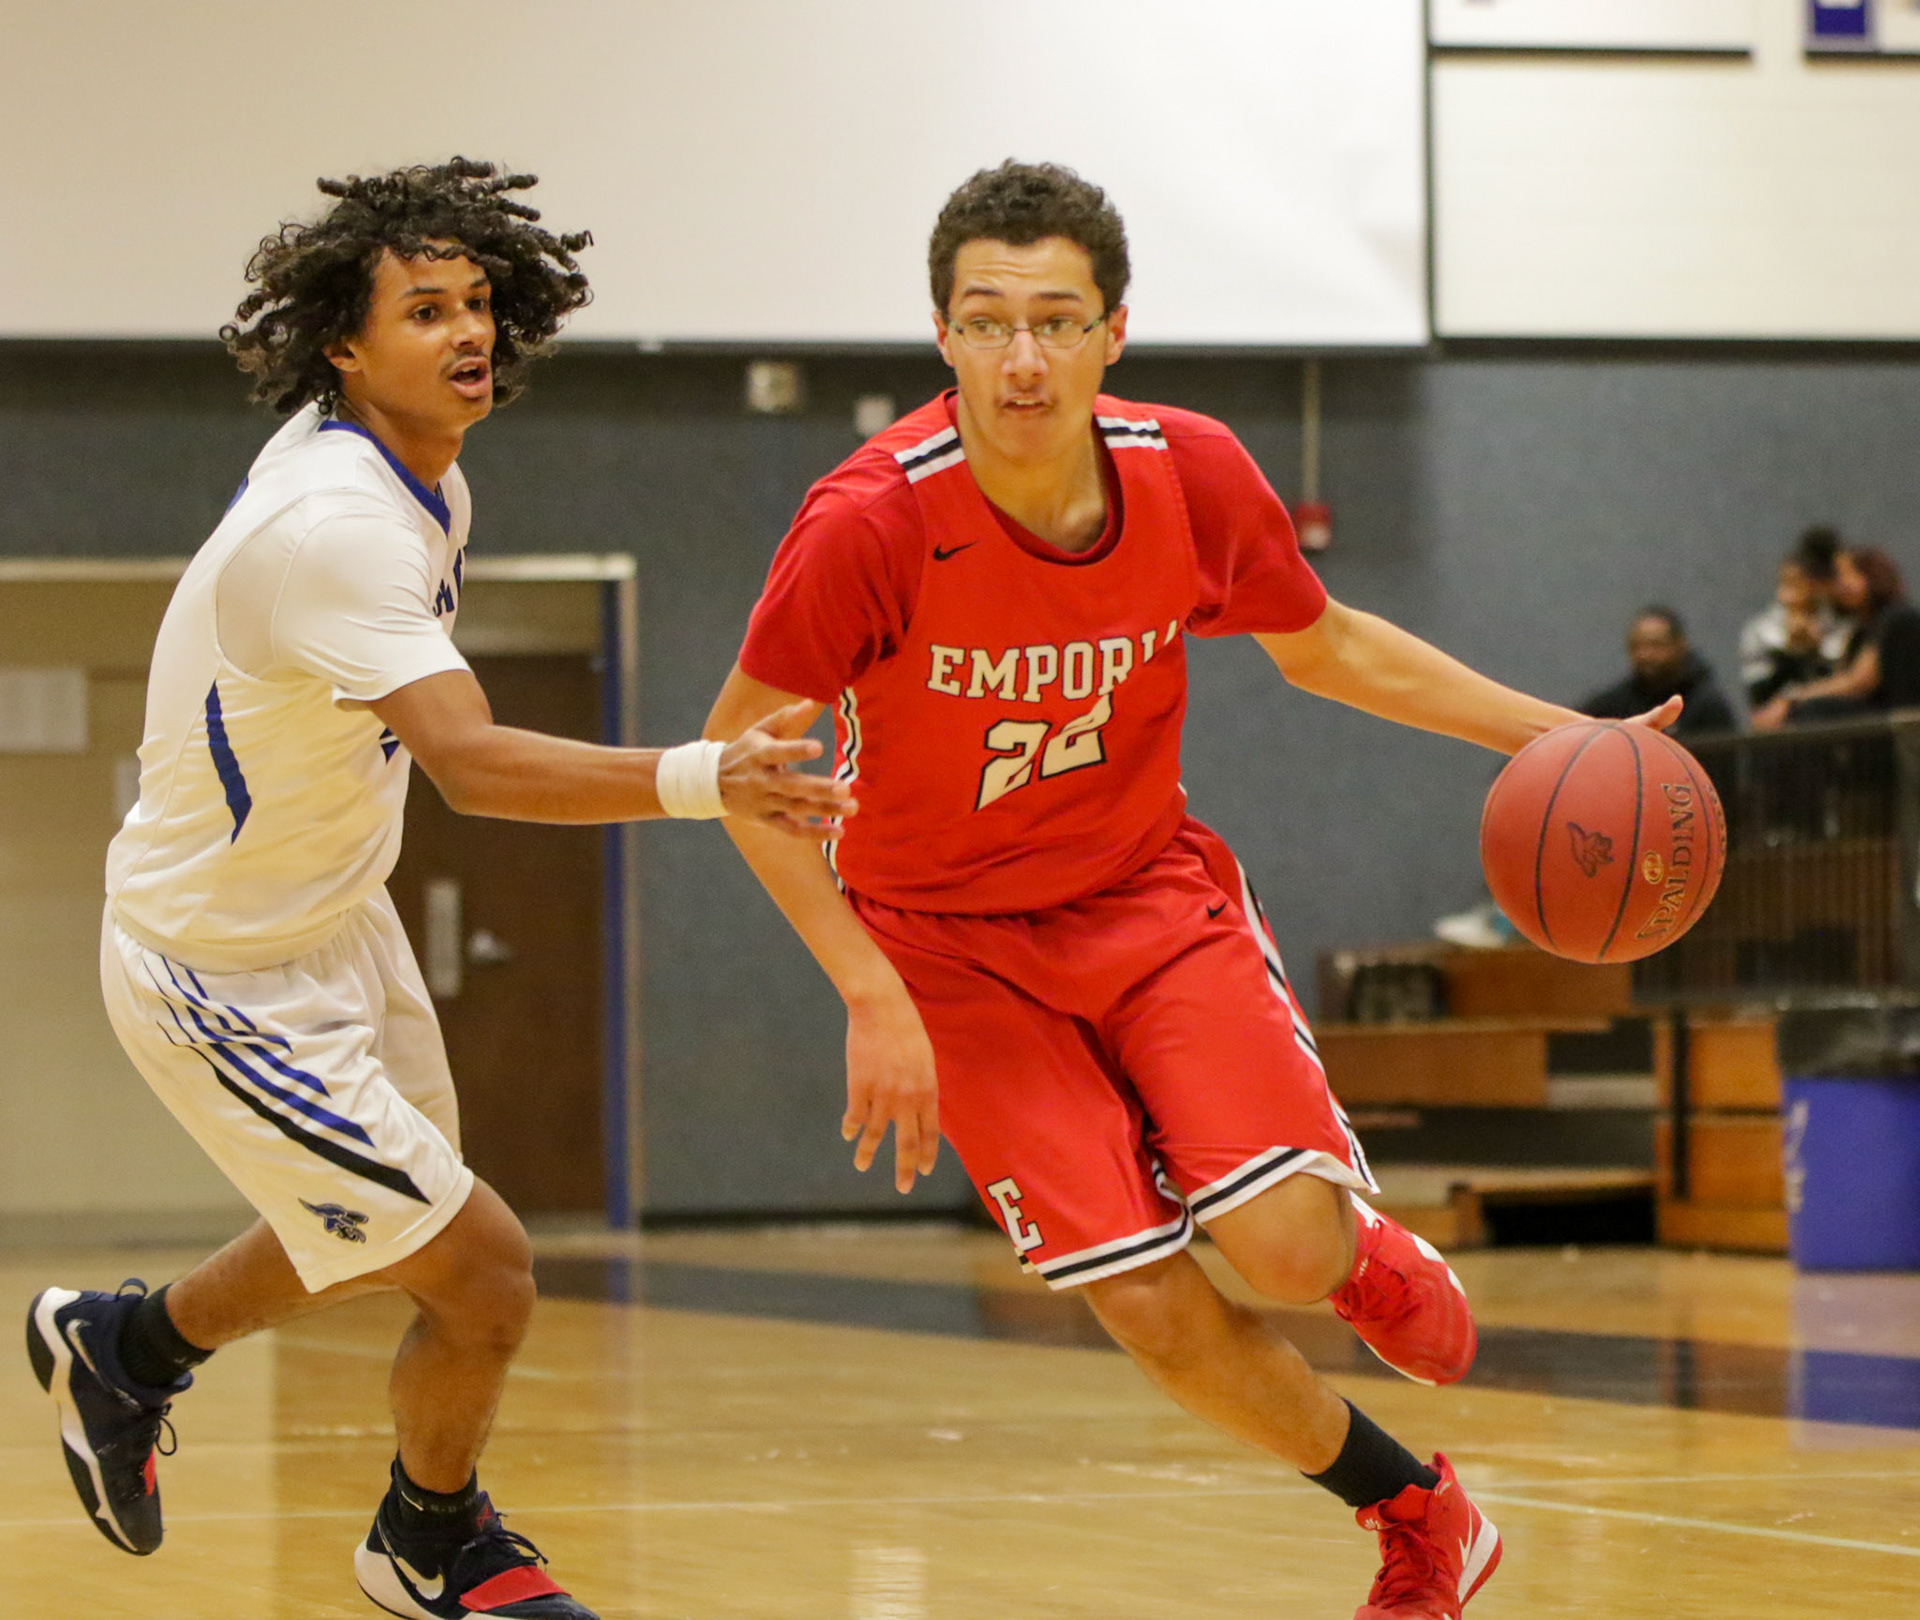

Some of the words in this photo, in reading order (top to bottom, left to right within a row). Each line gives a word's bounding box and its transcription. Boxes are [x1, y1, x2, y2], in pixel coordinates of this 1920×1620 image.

[974, 692, 1113, 811] 22
[1636, 783, 1695, 939] SPALDING
[986, 1176, 1045, 1252] E
